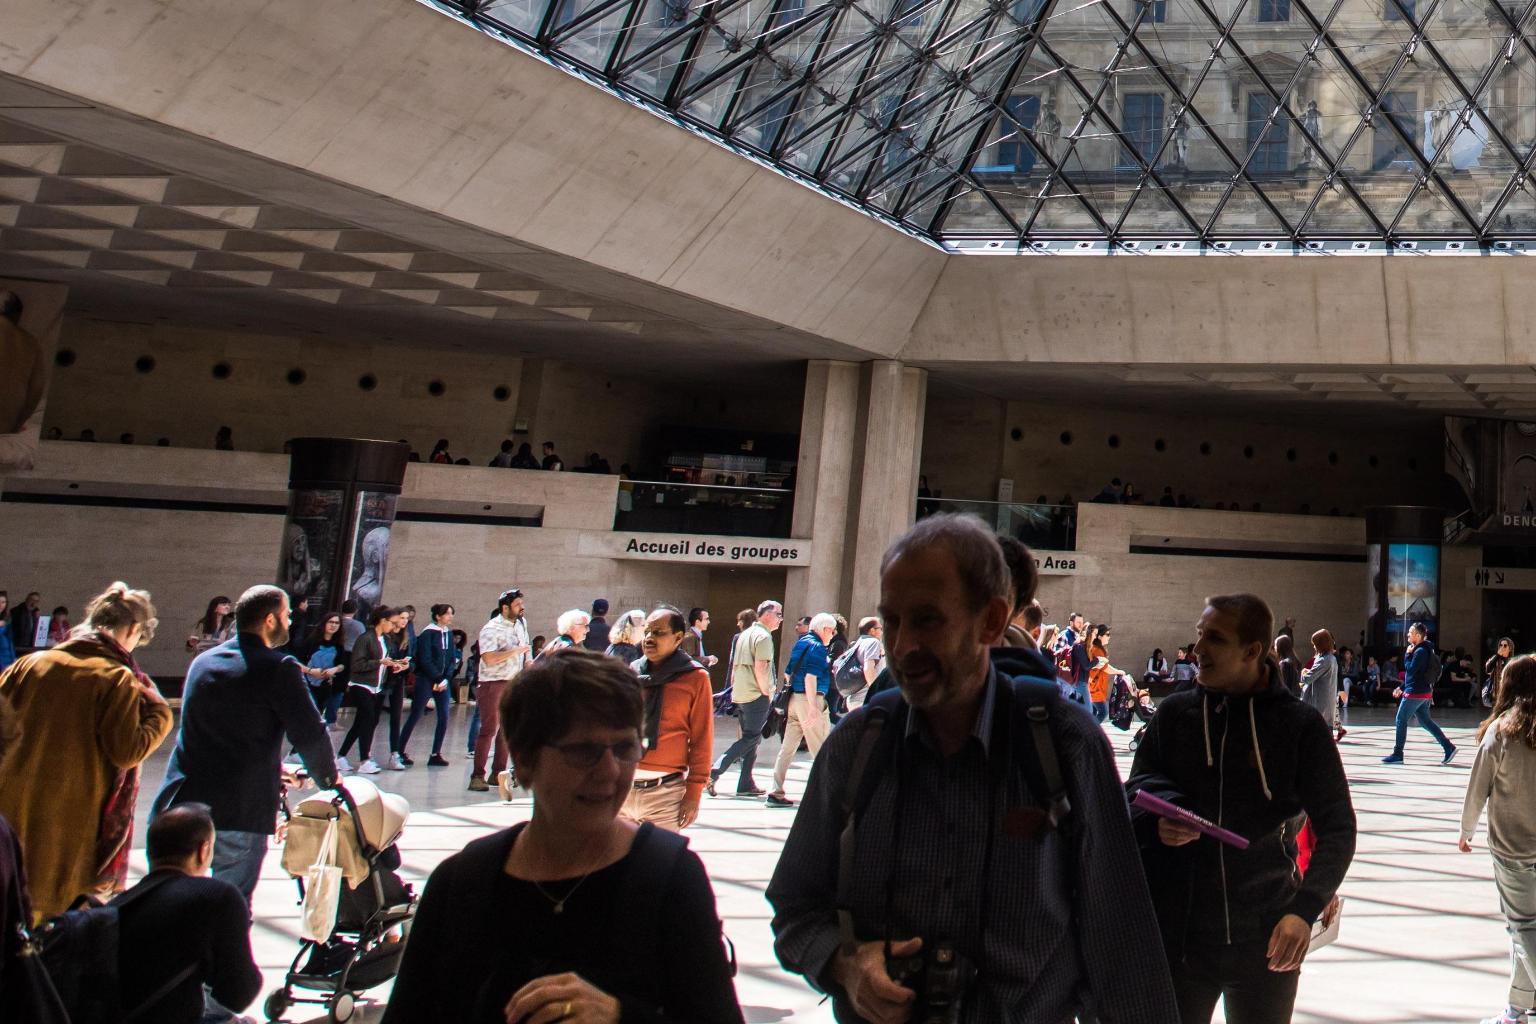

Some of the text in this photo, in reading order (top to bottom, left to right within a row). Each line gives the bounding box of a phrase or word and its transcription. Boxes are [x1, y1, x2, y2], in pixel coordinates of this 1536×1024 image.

[626, 538, 798, 561] Accueil des groupes
[1044, 556, 1076, 569] Area
